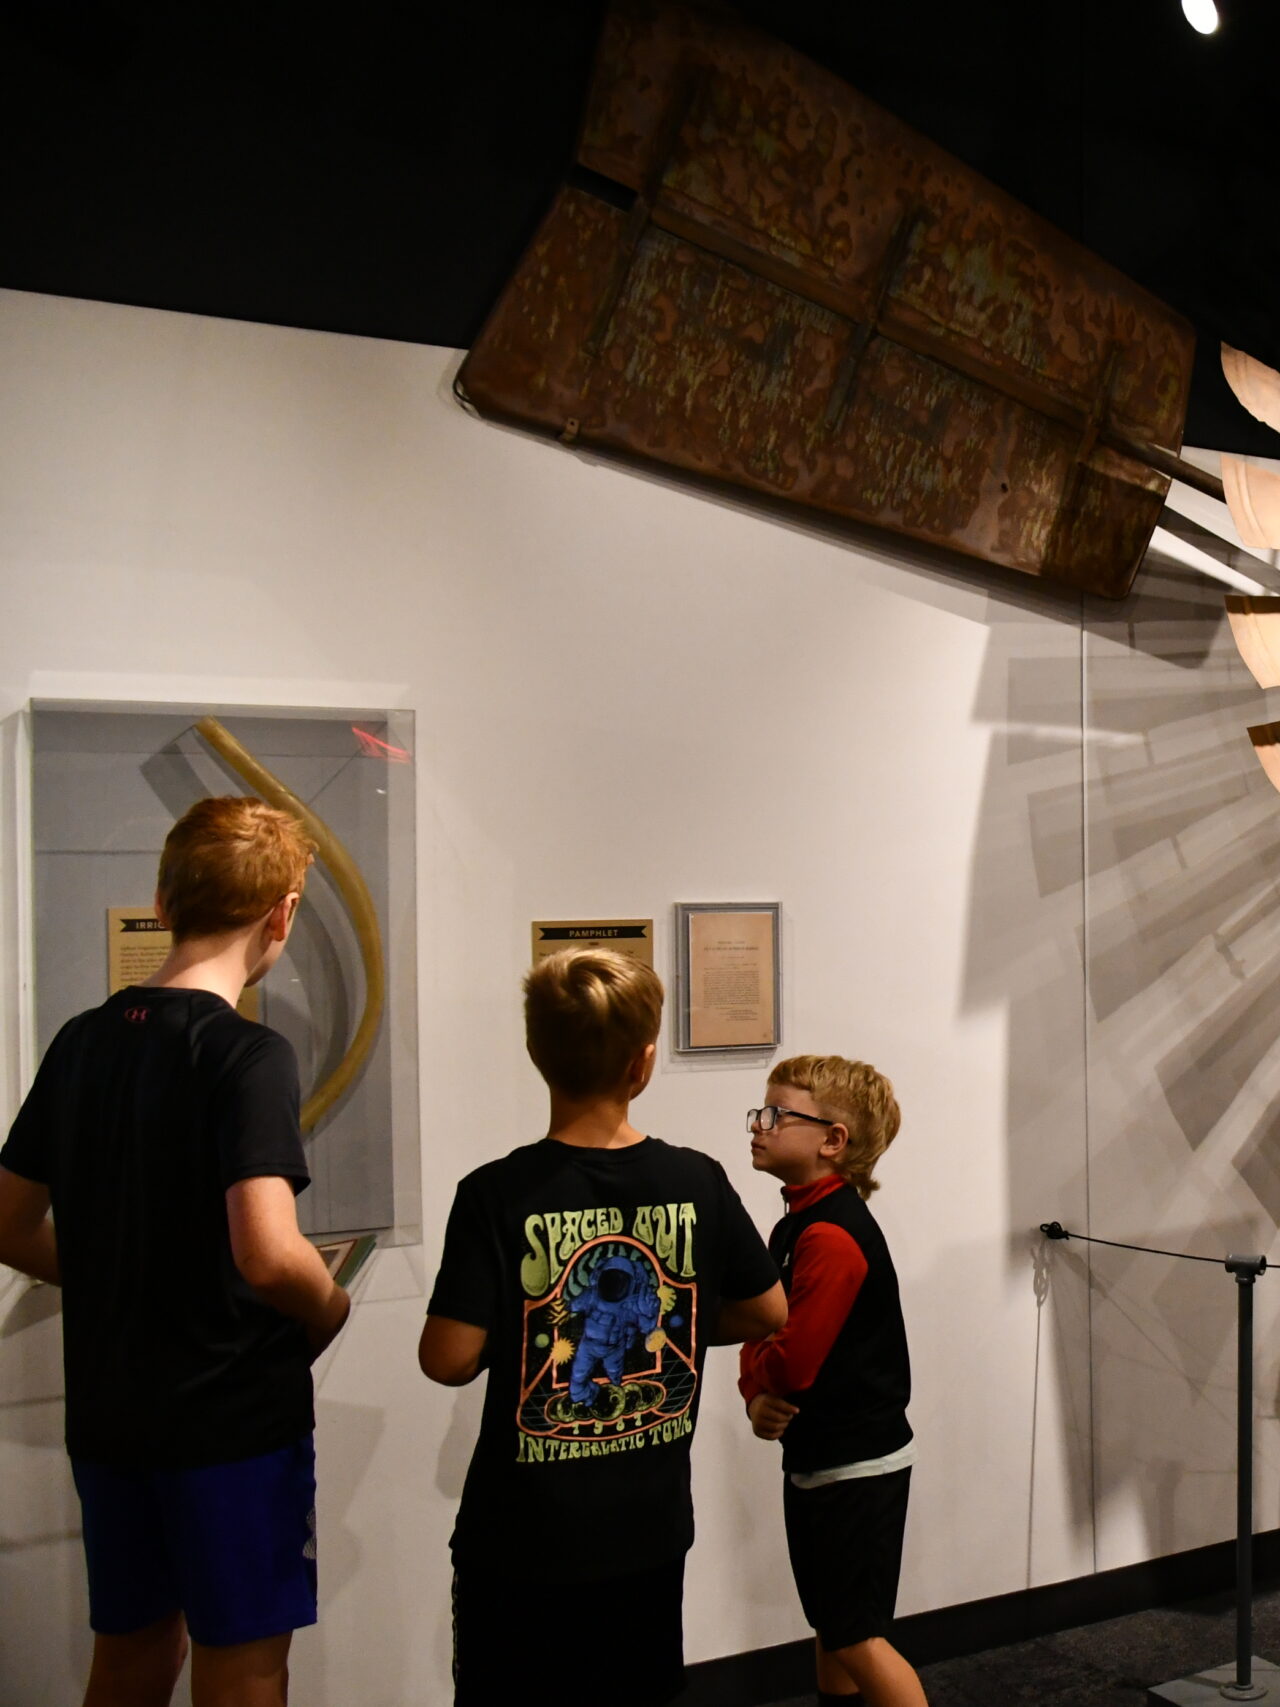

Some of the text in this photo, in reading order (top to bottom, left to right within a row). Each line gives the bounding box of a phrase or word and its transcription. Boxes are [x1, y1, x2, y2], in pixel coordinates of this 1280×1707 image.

[568, 929, 619, 937] PAMPHLET
[520, 1202, 697, 1297] SPACED OUT
